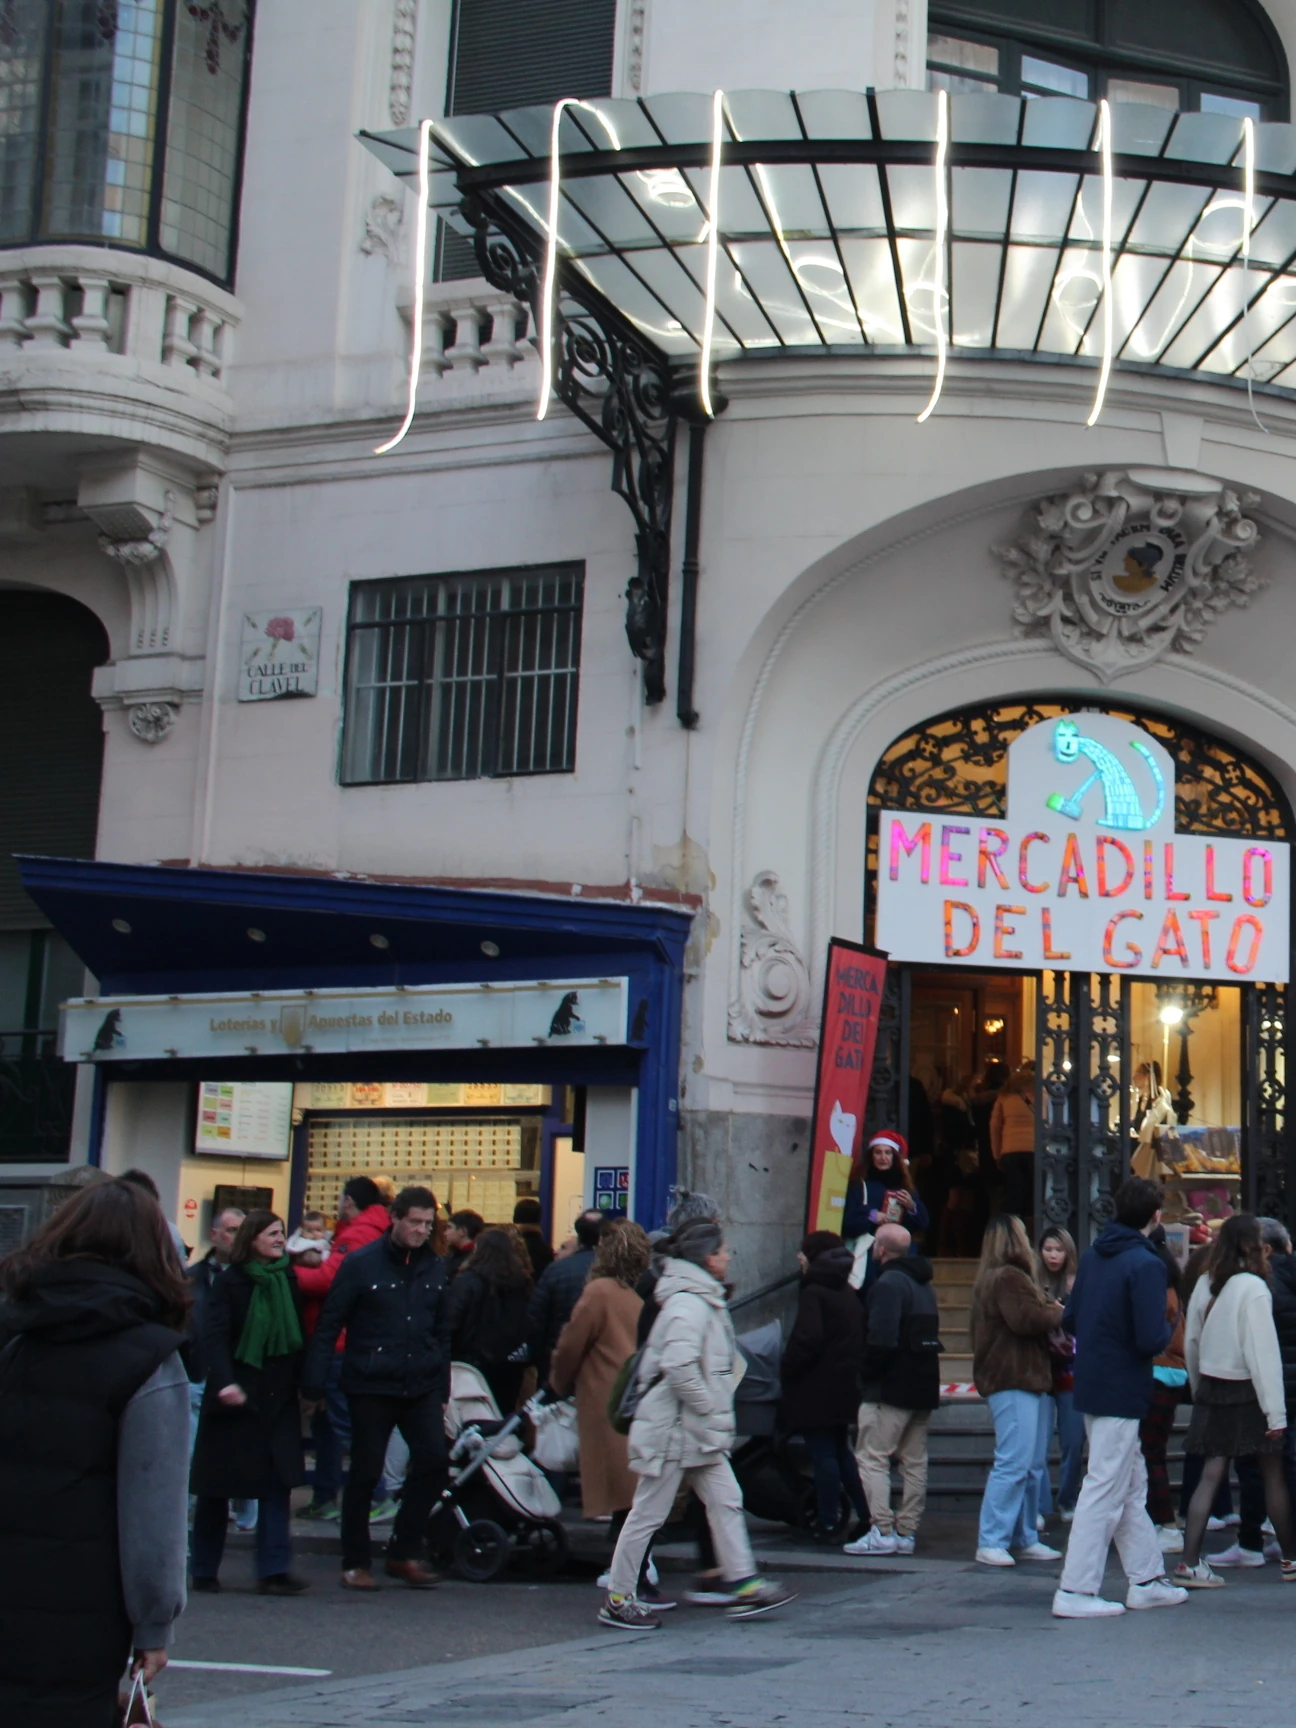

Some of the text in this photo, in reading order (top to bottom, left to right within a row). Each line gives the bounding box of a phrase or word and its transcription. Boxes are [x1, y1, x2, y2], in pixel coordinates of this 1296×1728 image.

[247, 661, 308, 679] CALLE DEL
[249, 676, 300, 696] CLAVEL
[889, 818, 1273, 908] MERCADILLO
[944, 899, 1264, 975] DEL GATO
[836, 966, 880, 997] MERCA
[309, 1012, 373, 1030] Apuestas
[377, 1010, 399, 1026] del
[403, 1008, 453, 1025] Estado
